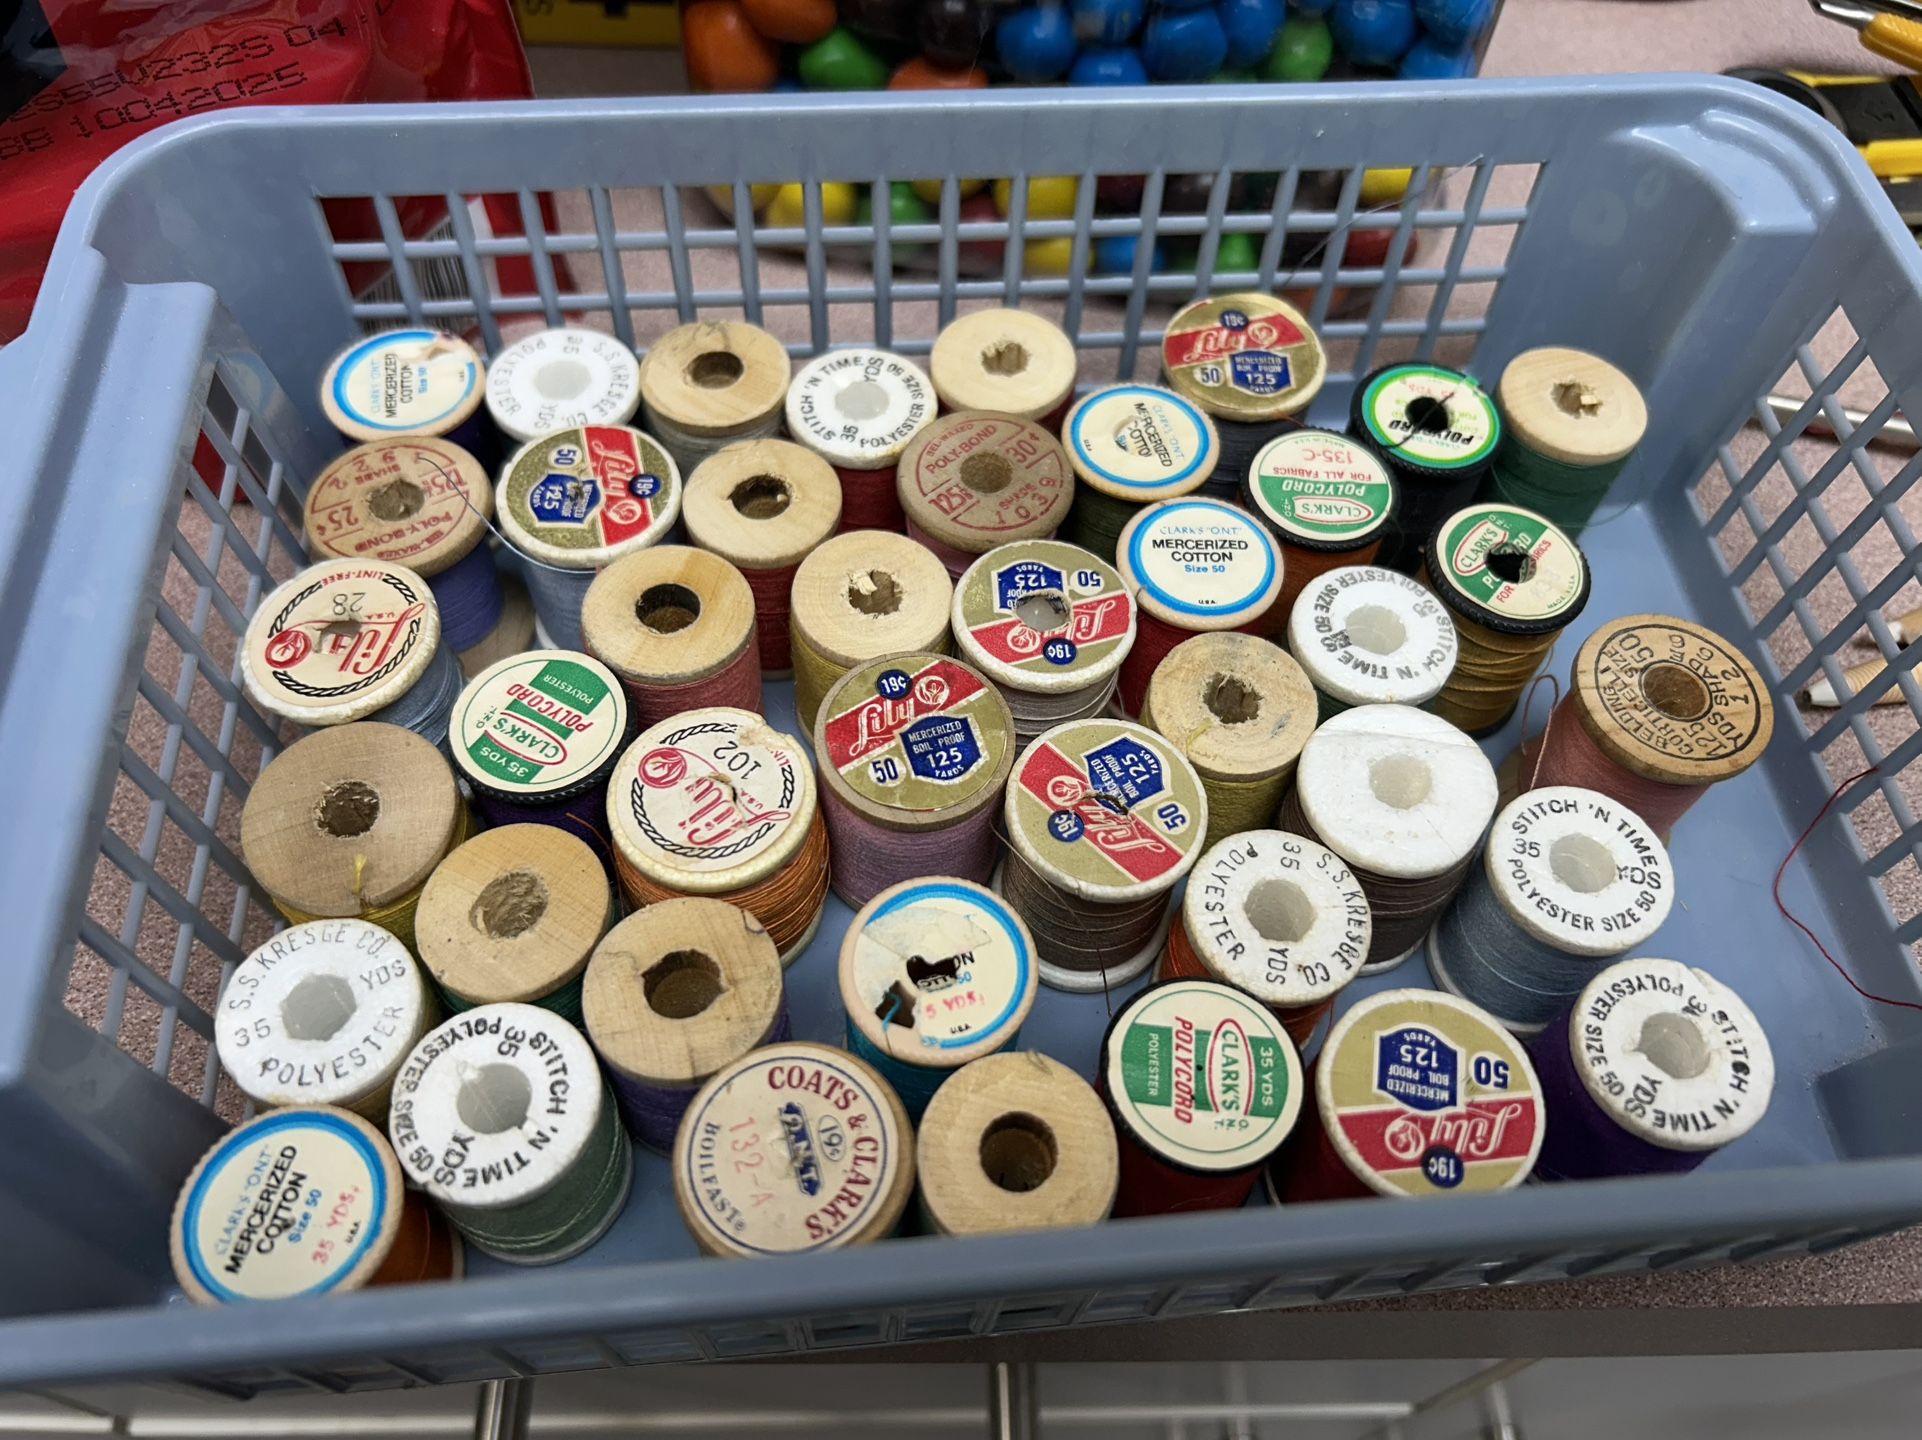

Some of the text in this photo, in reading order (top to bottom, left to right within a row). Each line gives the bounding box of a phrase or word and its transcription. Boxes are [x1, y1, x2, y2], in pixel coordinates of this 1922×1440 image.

[818, 355, 864, 376] TIME
[1200, 367, 1221, 384] 50
[1245, 373, 1276, 386] 125
[800, 394, 837, 441] STITCH
[839, 356, 884, 443] 35 YDS
[860, 362, 925, 449] POLYESTER SIZE 50
[554, 448, 577, 467] 50
[925, 424, 997, 475] POLY-BOND
[1302, 448, 1353, 465] 135-C
[1273, 466, 1372, 481] FOR ALL FABRICS
[1282, 479, 1366, 497] POLYCORD
[544, 484, 564, 511] 125
[1301, 503, 1362, 518] CLARK'S
[1152, 538, 1249, 551] MERCERIZED
[1171, 550, 1233, 563] COTTON
[1460, 528, 1498, 568] CLARK'S
[321, 569, 384, 587] LINT-FREE
[1014, 573, 1048, 588] 125
[1077, 570, 1102, 587] 50
[1184, 564, 1226, 573] Size 50
[333, 592, 367, 617] 28
[1314, 583, 1340, 614] SIZE
[1412, 599, 1439, 618] 35
[1496, 585, 1515, 604] FOR
[1314, 615, 1333, 634] 50
[1422, 615, 1455, 672] STITCH
[1337, 650, 1390, 681] TIME
[1600, 632, 1655, 680] SIZE 50
[506, 683, 594, 733] POLYCORD
[543, 674, 594, 705] POLYESTER
[849, 696, 916, 756] Lily
[1598, 664, 1695, 756] CORTICELLI
[1602, 685, 1670, 750] BELDING
[493, 717, 560, 760] CLARK'S
[908, 720, 962, 743] MERCERIZED
[1681, 711, 1745, 757] 125 YDS
[480, 746, 530, 778] 35 YDS
[713, 740, 763, 780] 102
[872, 757, 899, 784] 50
[926, 747, 963, 769] 125
[934, 764, 965, 778] YARDS
[1103, 754, 1140, 799] BOIL PROOF
[1121, 753, 1151, 785] 125
[1140, 749, 1160, 775] YARDS
[1157, 803, 1187, 832] 50
[1512, 798, 1658, 868] STITCH 'N TIME
[1512, 836, 1662, 890] 35 YDS
[1204, 840, 1260, 961] POLYESTER
[1265, 841, 1303, 985] 35 YDS
[1507, 858, 1657, 932] POLYESTER SIZE 50
[233, 958, 407, 1049] 35 YDS
[258, 1005, 405, 1087] POLYESTER
[1403, 1030, 1437, 1048] YARDS
[1584, 973, 1685, 1098] POLYESTER SIZE 50
[528, 1031, 571, 1116] STITCH
[1147, 1031, 1162, 1098] POLYESTER
[1173, 1015, 1194, 1125] POLYCORD
[1221, 1028, 1242, 1113] CLARK'S
[1387, 1063, 1450, 1086] BOIL PROOF
[1399, 1044, 1440, 1068] 125
[1473, 1055, 1511, 1091] 50
[394, 1015, 503, 1173] POLYESTER SIZE 50
[1259, 1045, 1274, 1108] 35 YDS
[1386, 1077, 1450, 1102] MERCERIZED
[433, 1025, 527, 1187] 35 YDS
[1623, 1074, 1664, 1120] YDS
[1429, 1103, 1523, 1157] Lily
[1651, 1108, 1718, 1133] TIME
[462, 1150, 531, 1189] TIME
[728, 1115, 776, 1208] 132-A
[767, 1064, 880, 1241] COATS & CLARK'S
[223, 1144, 298, 1276] MERCERIZED
[255, 1170, 308, 1255] COTTON
[287, 1188, 323, 1245] Size 50
[311, 1237, 336, 1266] 35
